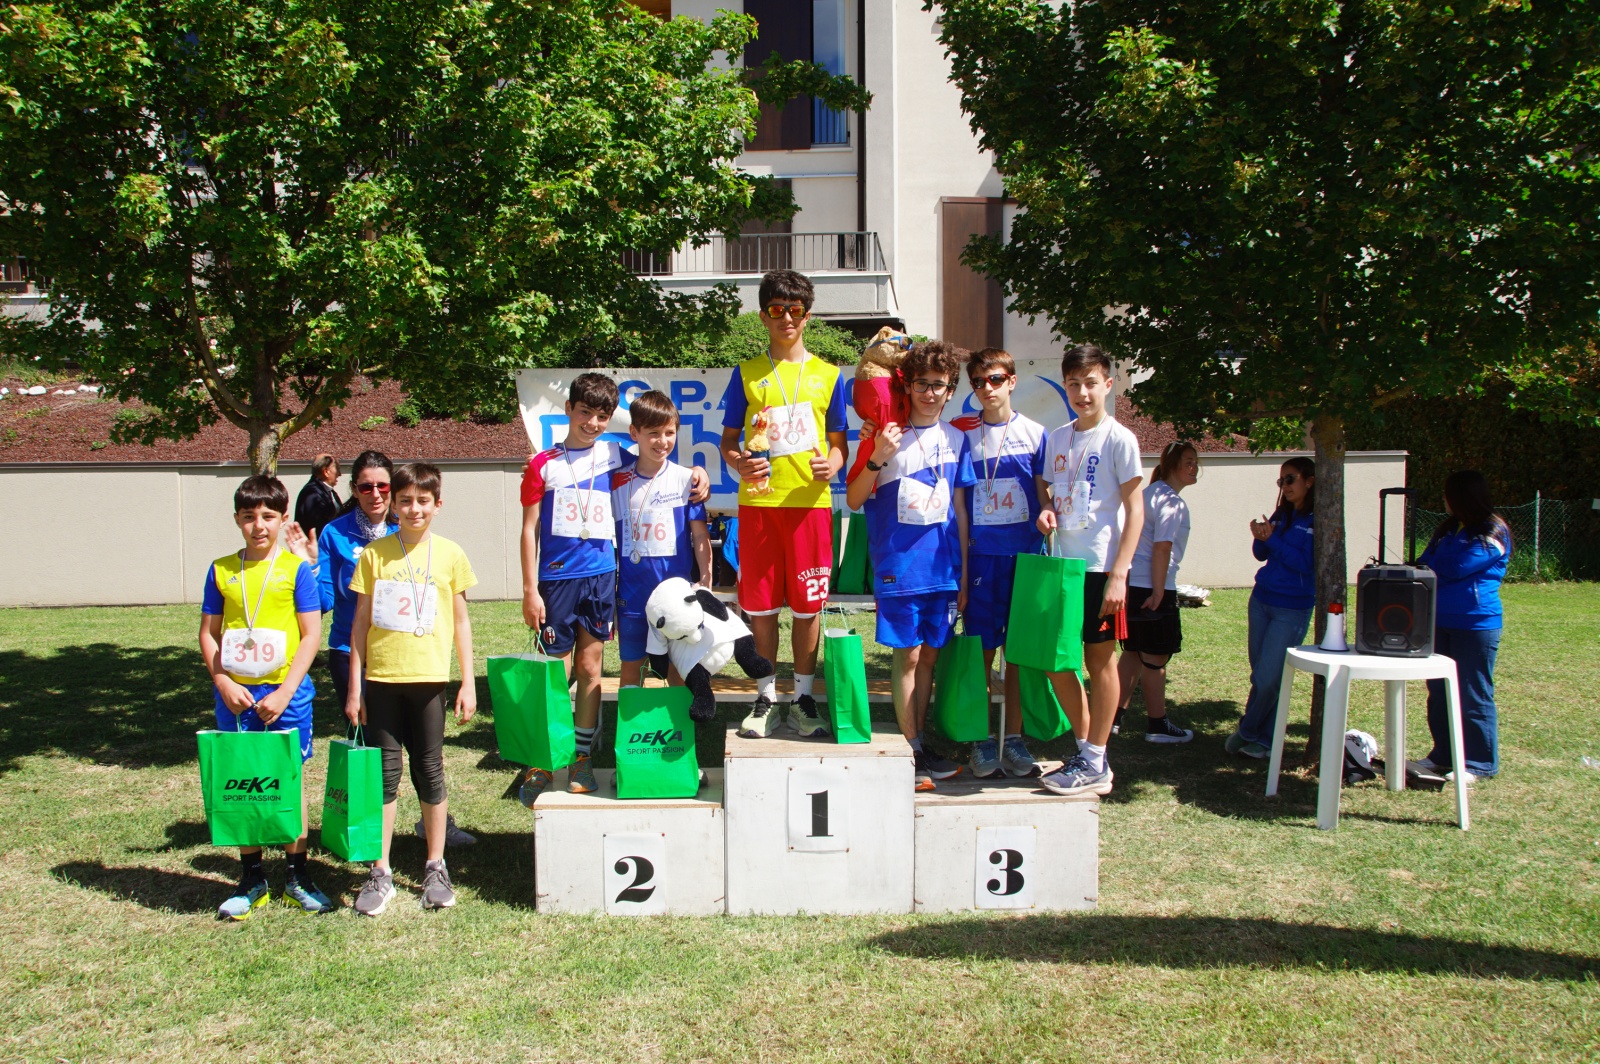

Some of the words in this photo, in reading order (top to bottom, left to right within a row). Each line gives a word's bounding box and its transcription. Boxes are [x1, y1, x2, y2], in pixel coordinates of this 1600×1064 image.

[806, 576, 829, 602] 23
[397, 597, 412, 616] 2
[234, 643, 275, 663] 319
[628, 728, 683, 746] DEKA
[626, 747, 651, 755] SPORT
[652, 746, 685, 754] PASSION
[224, 776, 280, 793] DEKA
[222, 794, 247, 802] SPORT
[248, 794, 282, 802] PASSION
[805, 789, 834, 838] 1
[613, 855, 657, 904] 2
[986, 848, 1026, 897] 3
